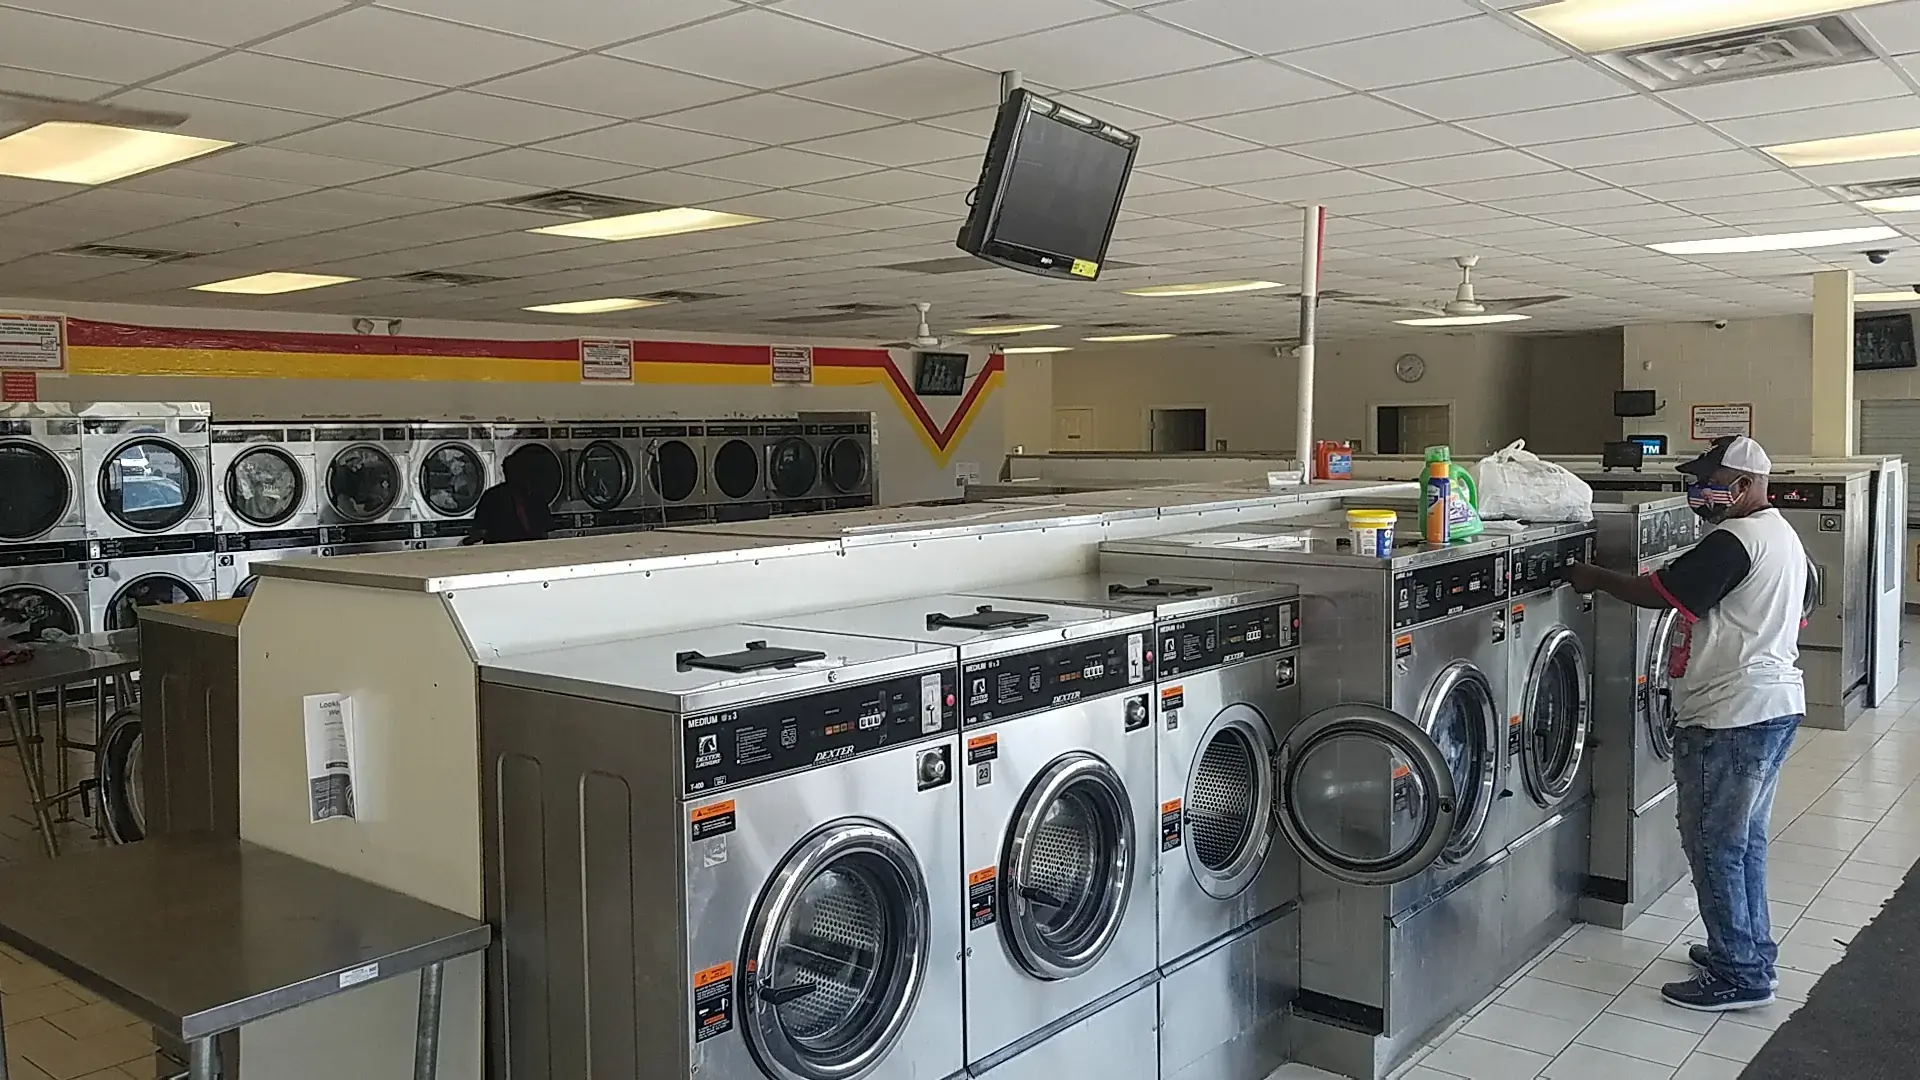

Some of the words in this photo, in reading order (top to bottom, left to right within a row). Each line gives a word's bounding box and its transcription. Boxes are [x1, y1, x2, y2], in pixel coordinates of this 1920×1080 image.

[1642, 445, 1660, 454] TM
[965, 661, 987, 673] MEDIUM
[1052, 690, 1081, 704] DEXTER
[688, 715, 718, 728] MEDIUM
[695, 752, 722, 763] DEXTER
[814, 744, 855, 762] DEXTER
[979, 767, 989, 780] 23
[689, 781, 705, 792] T-400
